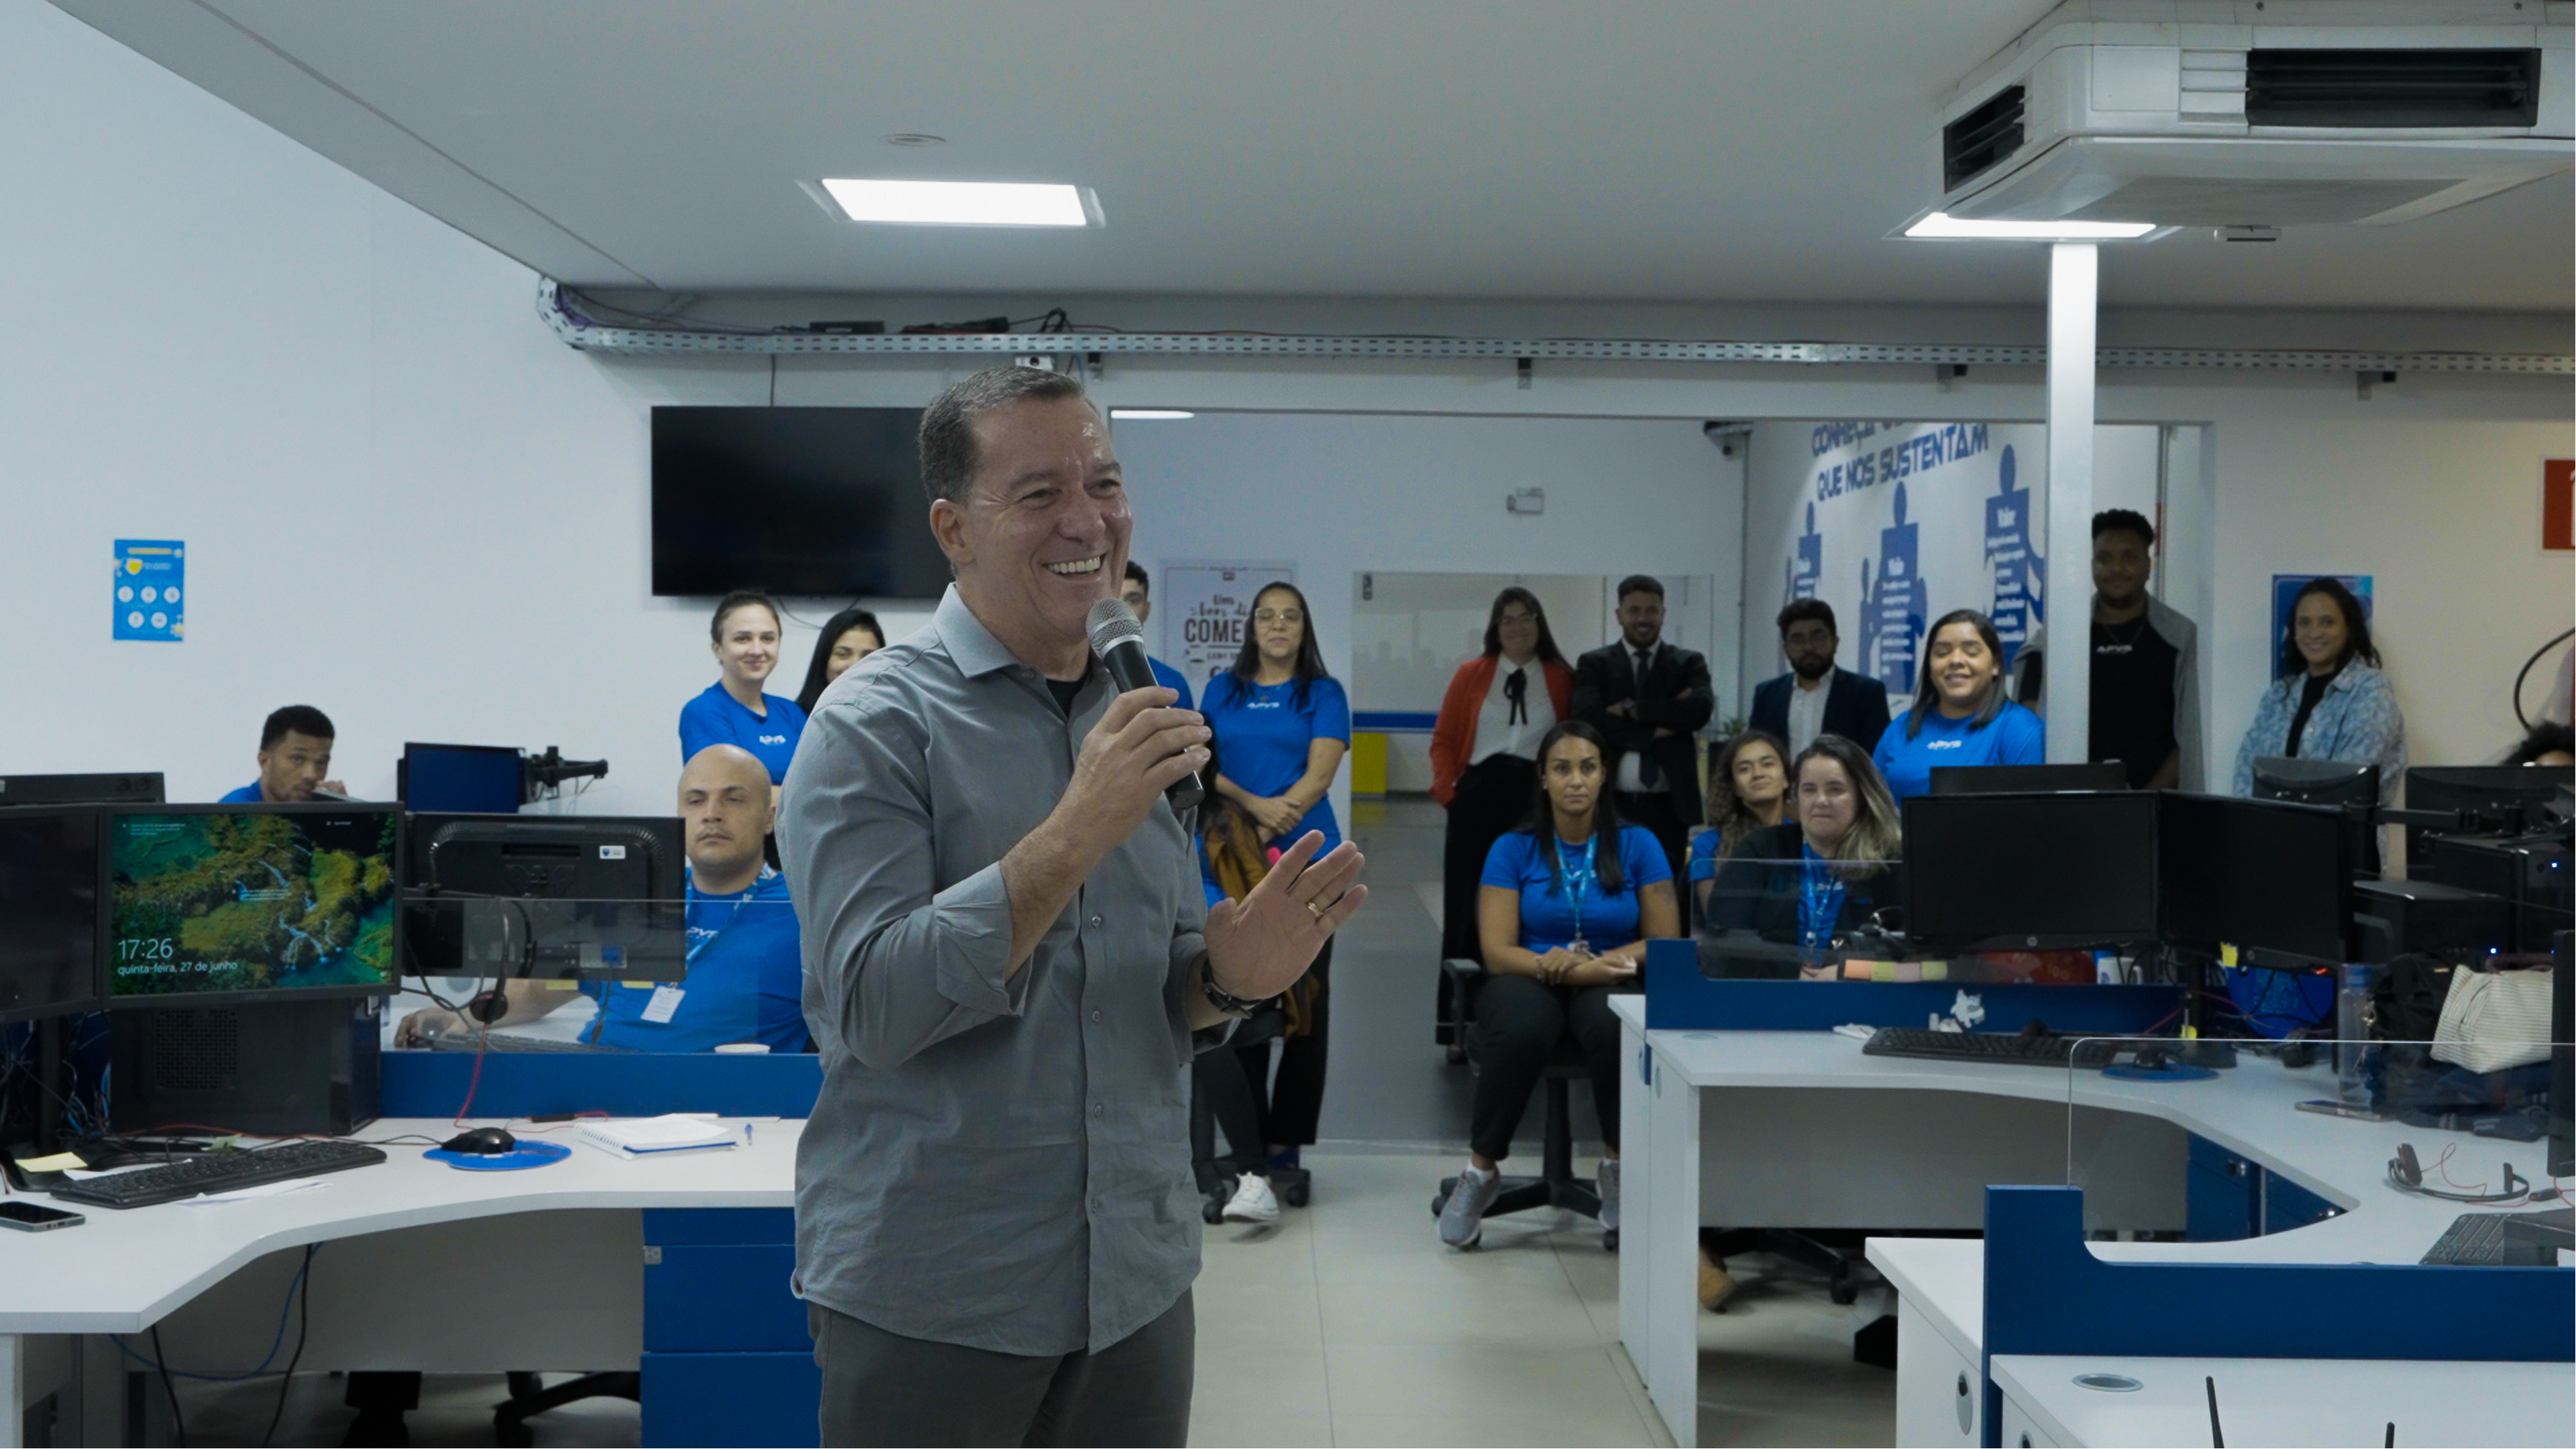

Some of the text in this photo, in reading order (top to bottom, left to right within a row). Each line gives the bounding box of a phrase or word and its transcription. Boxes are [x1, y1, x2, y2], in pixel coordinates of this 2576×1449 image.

[1817, 423, 1988, 501] QUE NOS SUSTENTAM
[1185, 618, 1244, 643] COME
[118, 938, 173, 960] 17:26
[117, 961, 238, 977] quinta-feira, 27 de junho
